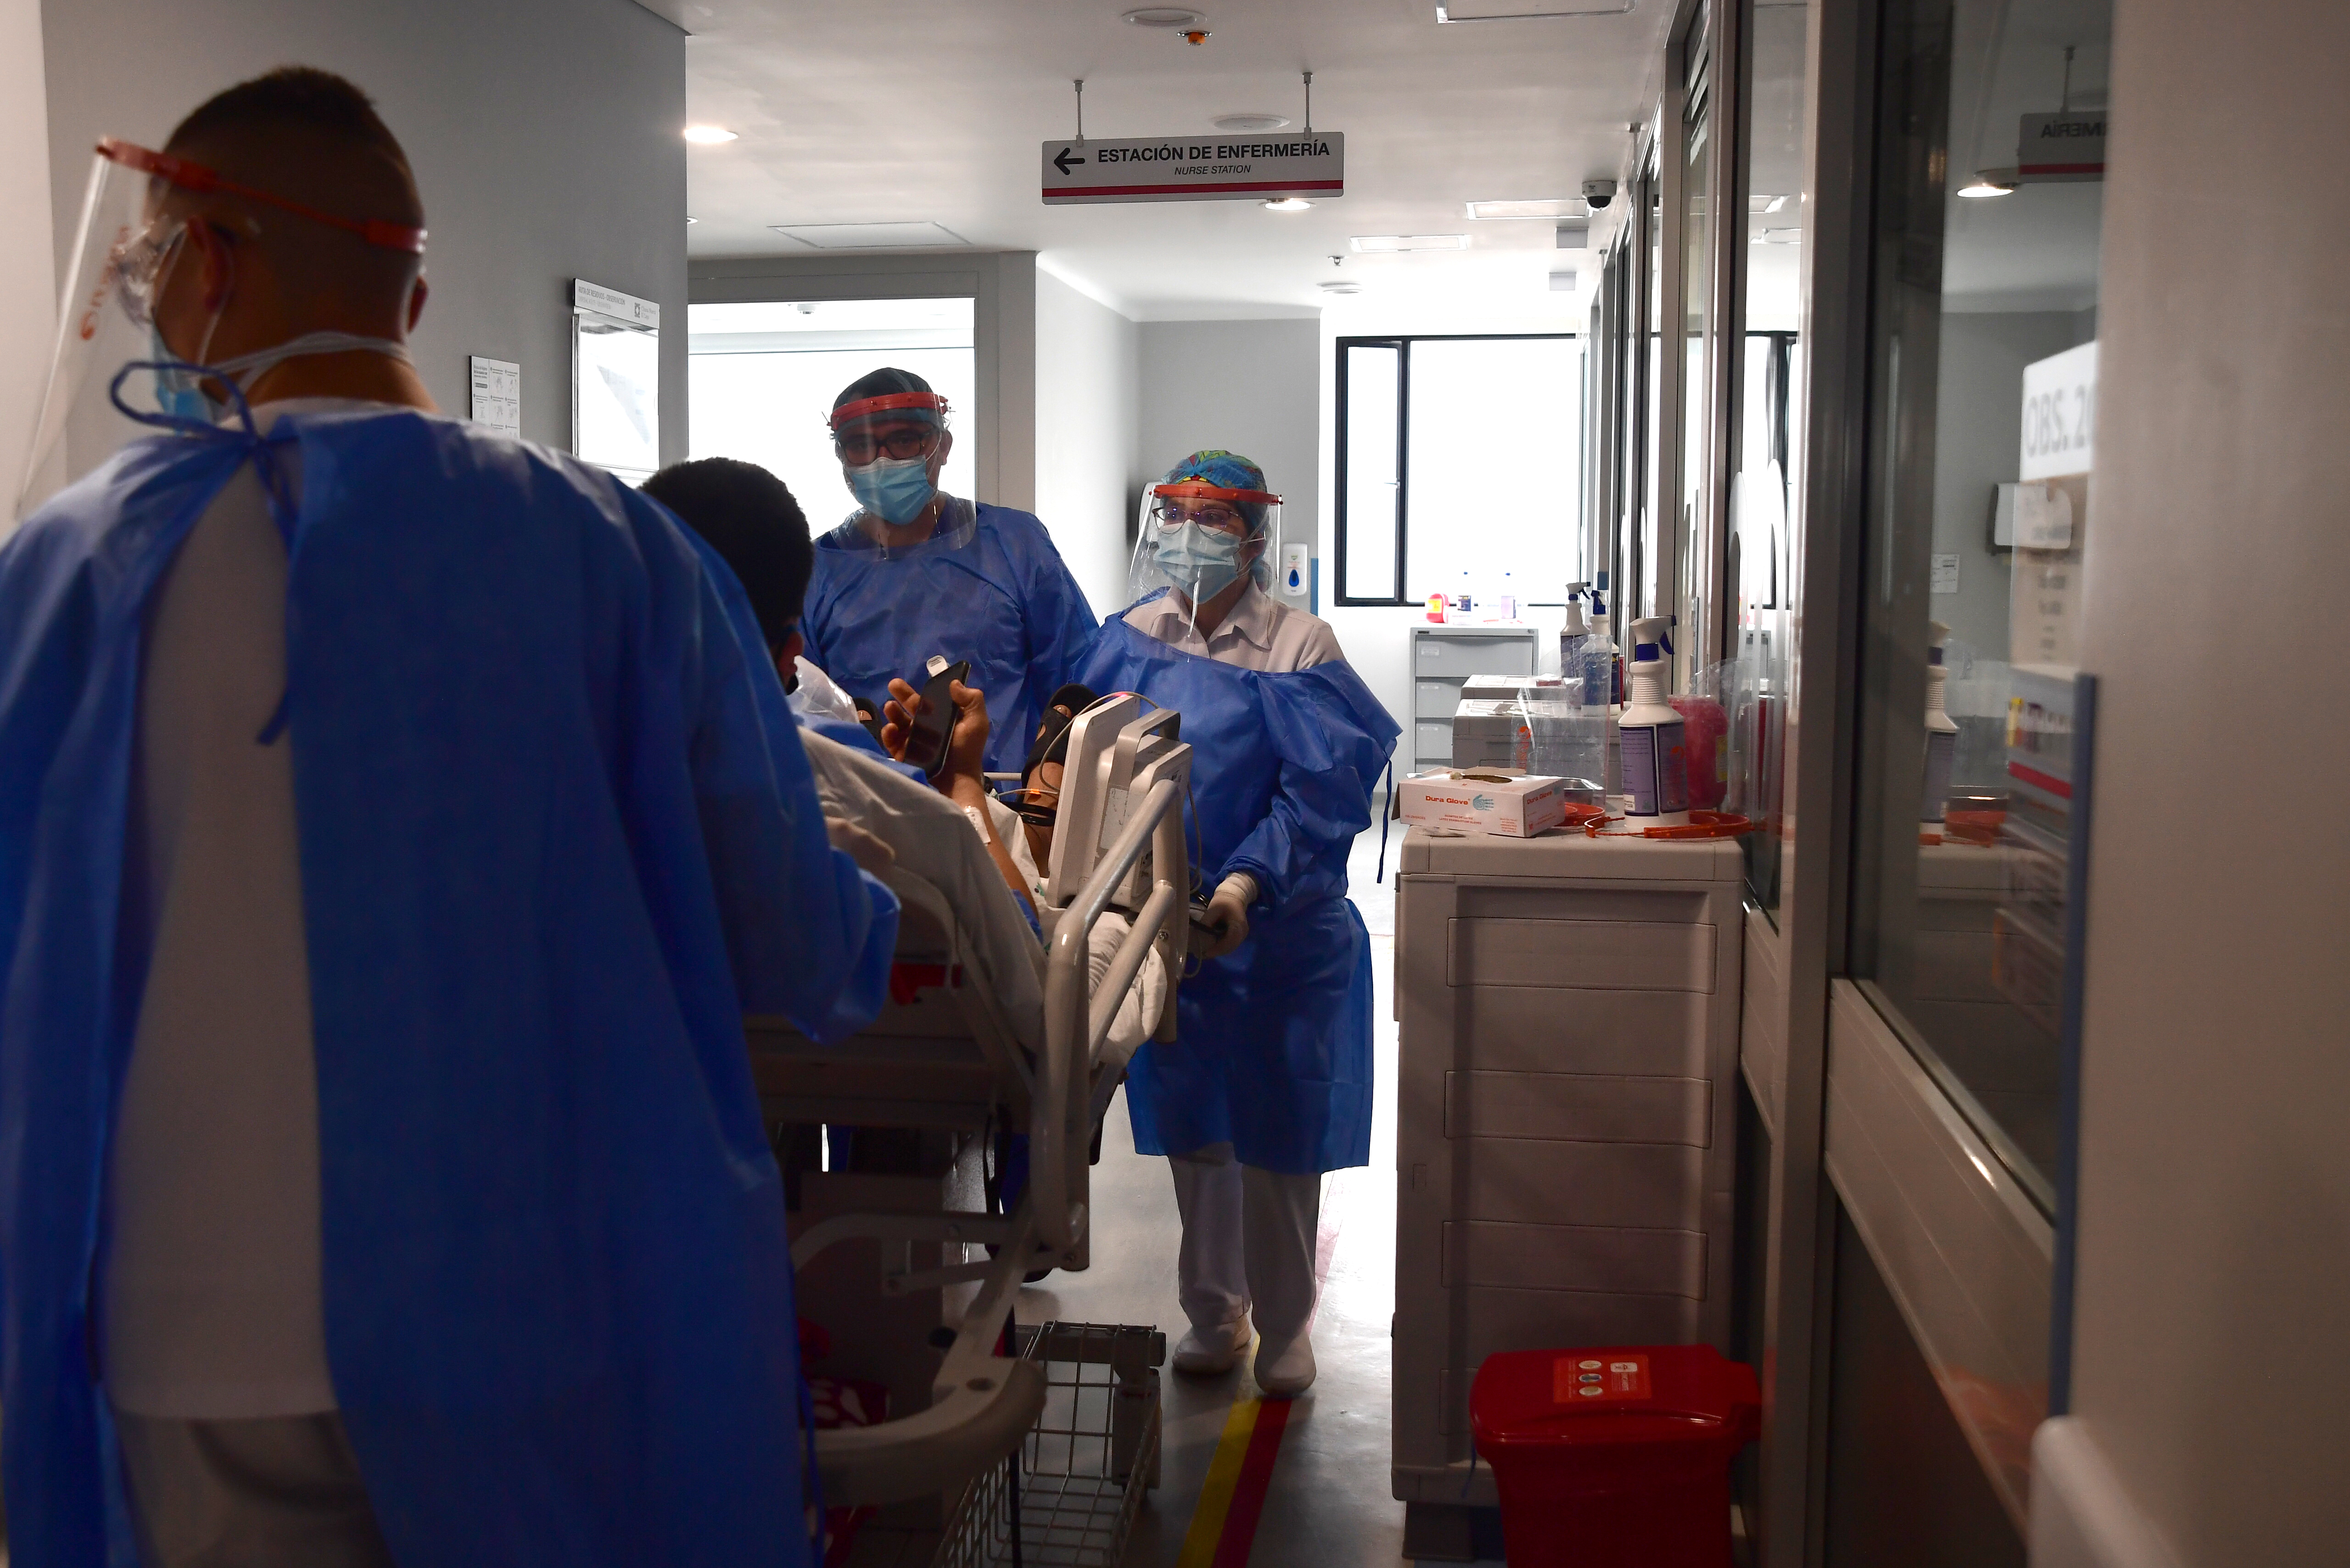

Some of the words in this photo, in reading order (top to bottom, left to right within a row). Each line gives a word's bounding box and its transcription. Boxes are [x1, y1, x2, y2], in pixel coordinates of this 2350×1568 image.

[1098, 144, 1186, 163] ESTACIÓN
[1190, 146, 1213, 160] DE
[1217, 139, 1330, 158] ENFERMERÍA
[1174, 166, 1209, 175] NURSE
[1211, 164, 1251, 175] STATION
[1446, 797, 1469, 805] Glove
